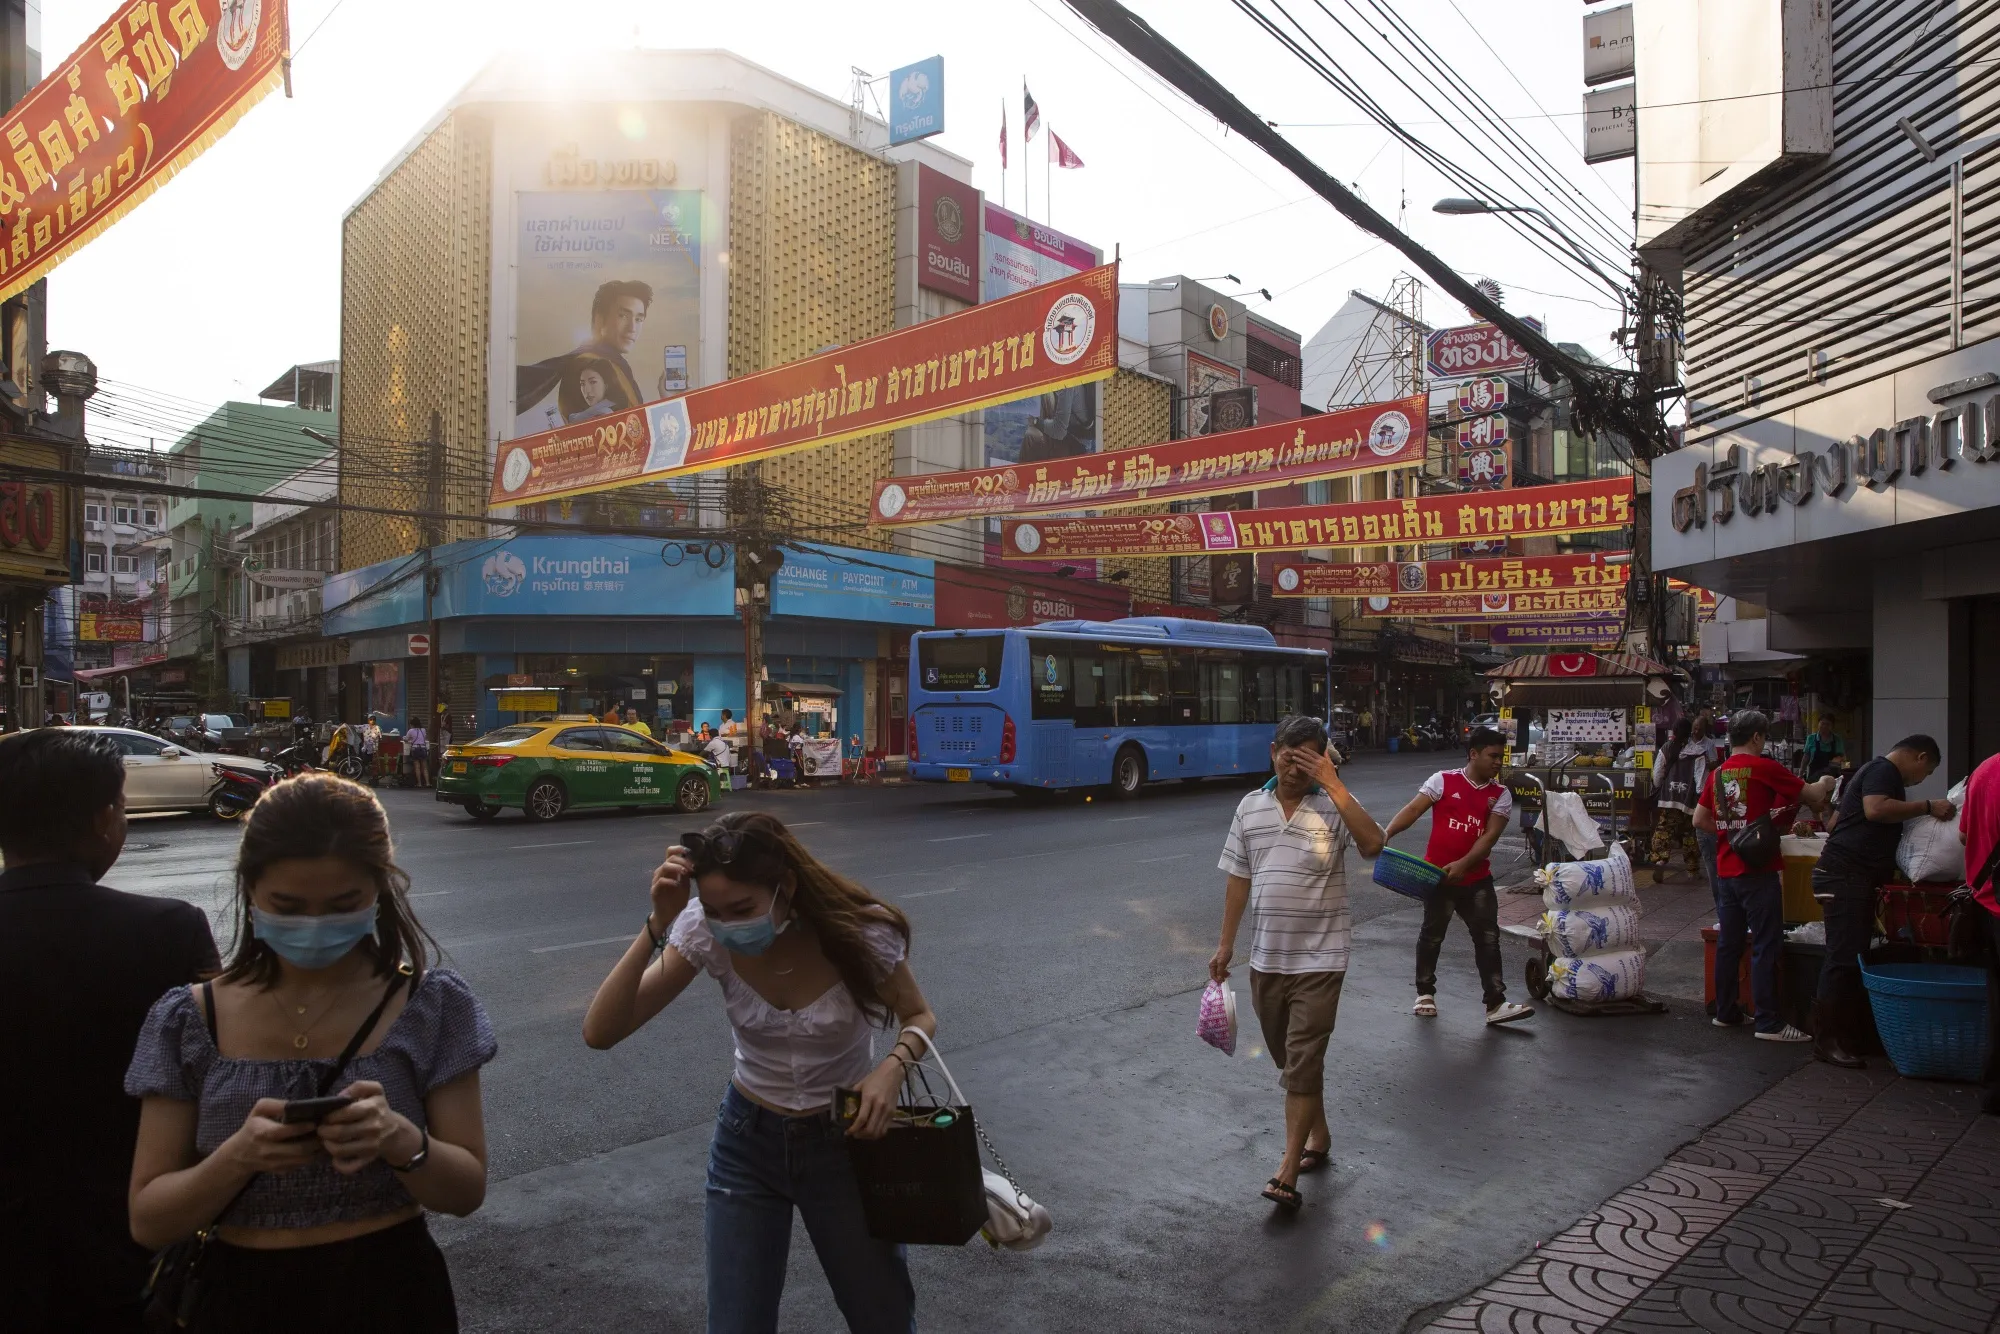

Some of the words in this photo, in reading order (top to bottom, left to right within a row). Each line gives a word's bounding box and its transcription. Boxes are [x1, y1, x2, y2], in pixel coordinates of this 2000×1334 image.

[895, 115, 934, 137] กรุงไทย
[526, 213, 624, 232] แลกผ่านแอป
[534, 233, 615, 253] ใช้ผ่านบัตร
[649, 232, 693, 246] NEXT
[1033, 227, 1065, 251] ออมสิน
[928, 251, 970, 279] ออมสิน
[1443, 330, 1488, 346] ห้างทอง
[694, 364, 881, 453] บมจ.ธนาคารกรุงไทย
[884, 329, 1035, 407] สาขาเยาวราช
[1181, 444, 1276, 484] เยาวราช
[1139, 515, 1196, 535] 2020
[1238, 500, 1443, 546] ธนาคารออมสิน
[1151, 533, 1191, 544] 新年快乐
[532, 556, 630, 579] Krungthai
[532, 579, 580, 595] กรุงไทย
[778, 565, 828, 582] EXCHANGE
[842, 572, 885, 588] PAYPOINT
[901, 579, 918, 592] ATM
[1033, 598, 1075, 618] ออมสิน
[1467, 815, 1481, 827] Fly
